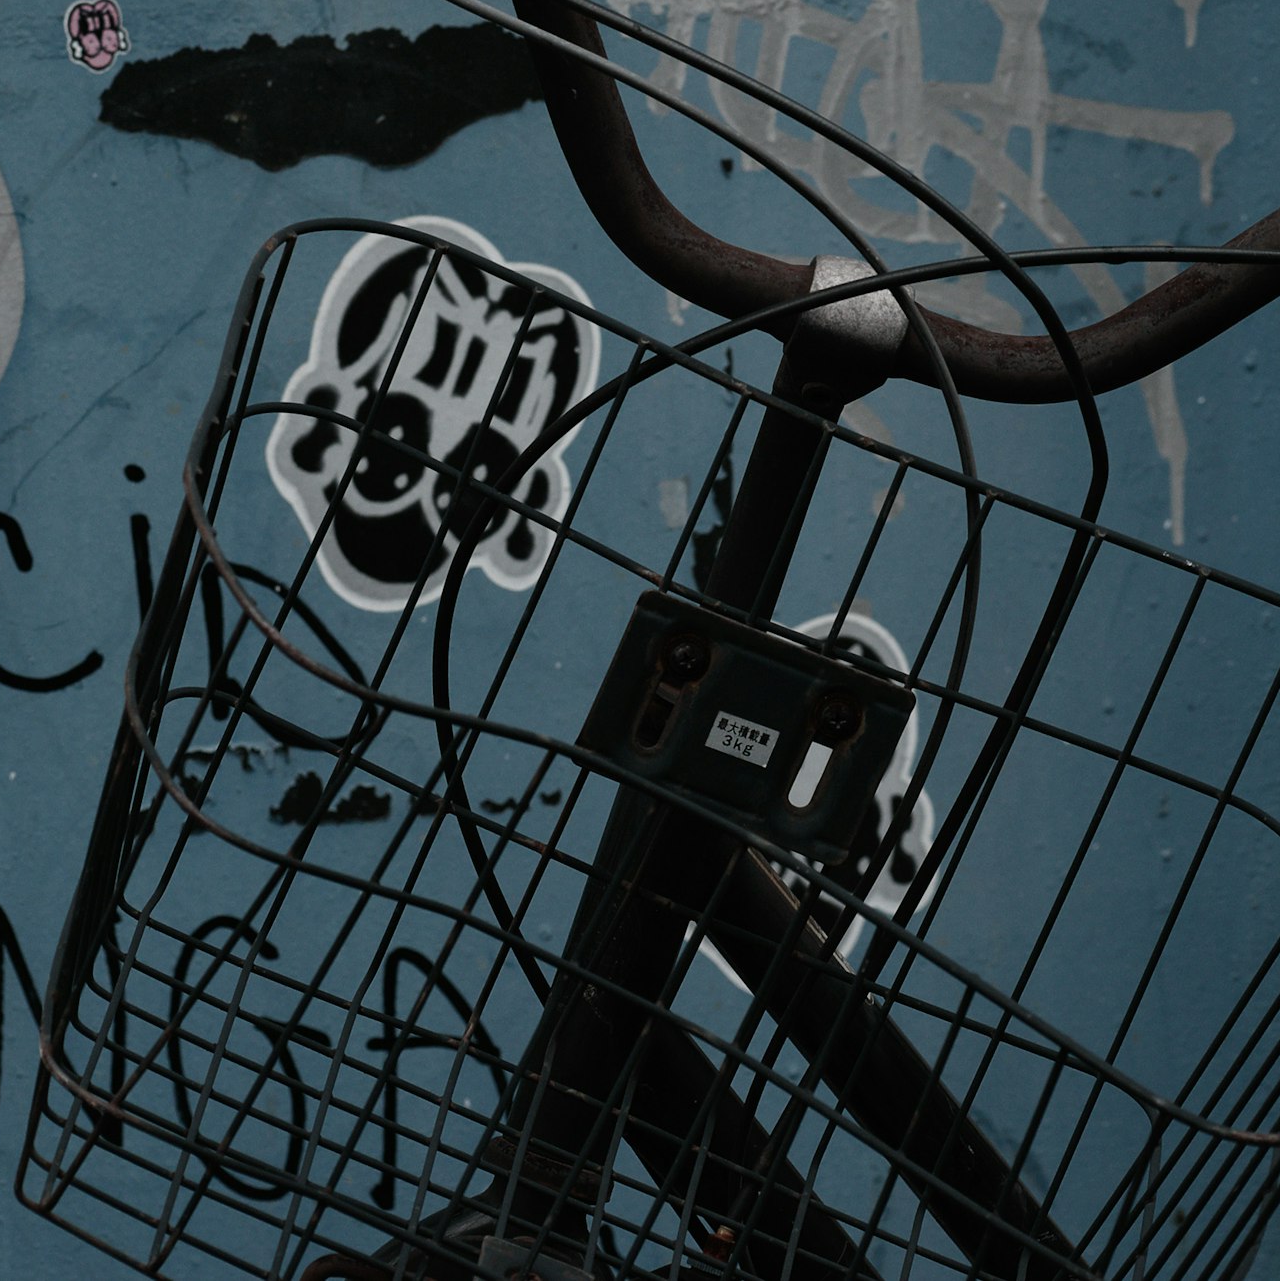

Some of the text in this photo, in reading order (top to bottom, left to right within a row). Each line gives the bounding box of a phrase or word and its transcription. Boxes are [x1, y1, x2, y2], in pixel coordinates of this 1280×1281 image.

[717, 718, 770, 746] 最大積載量
[722, 735, 754, 757] 3kg
